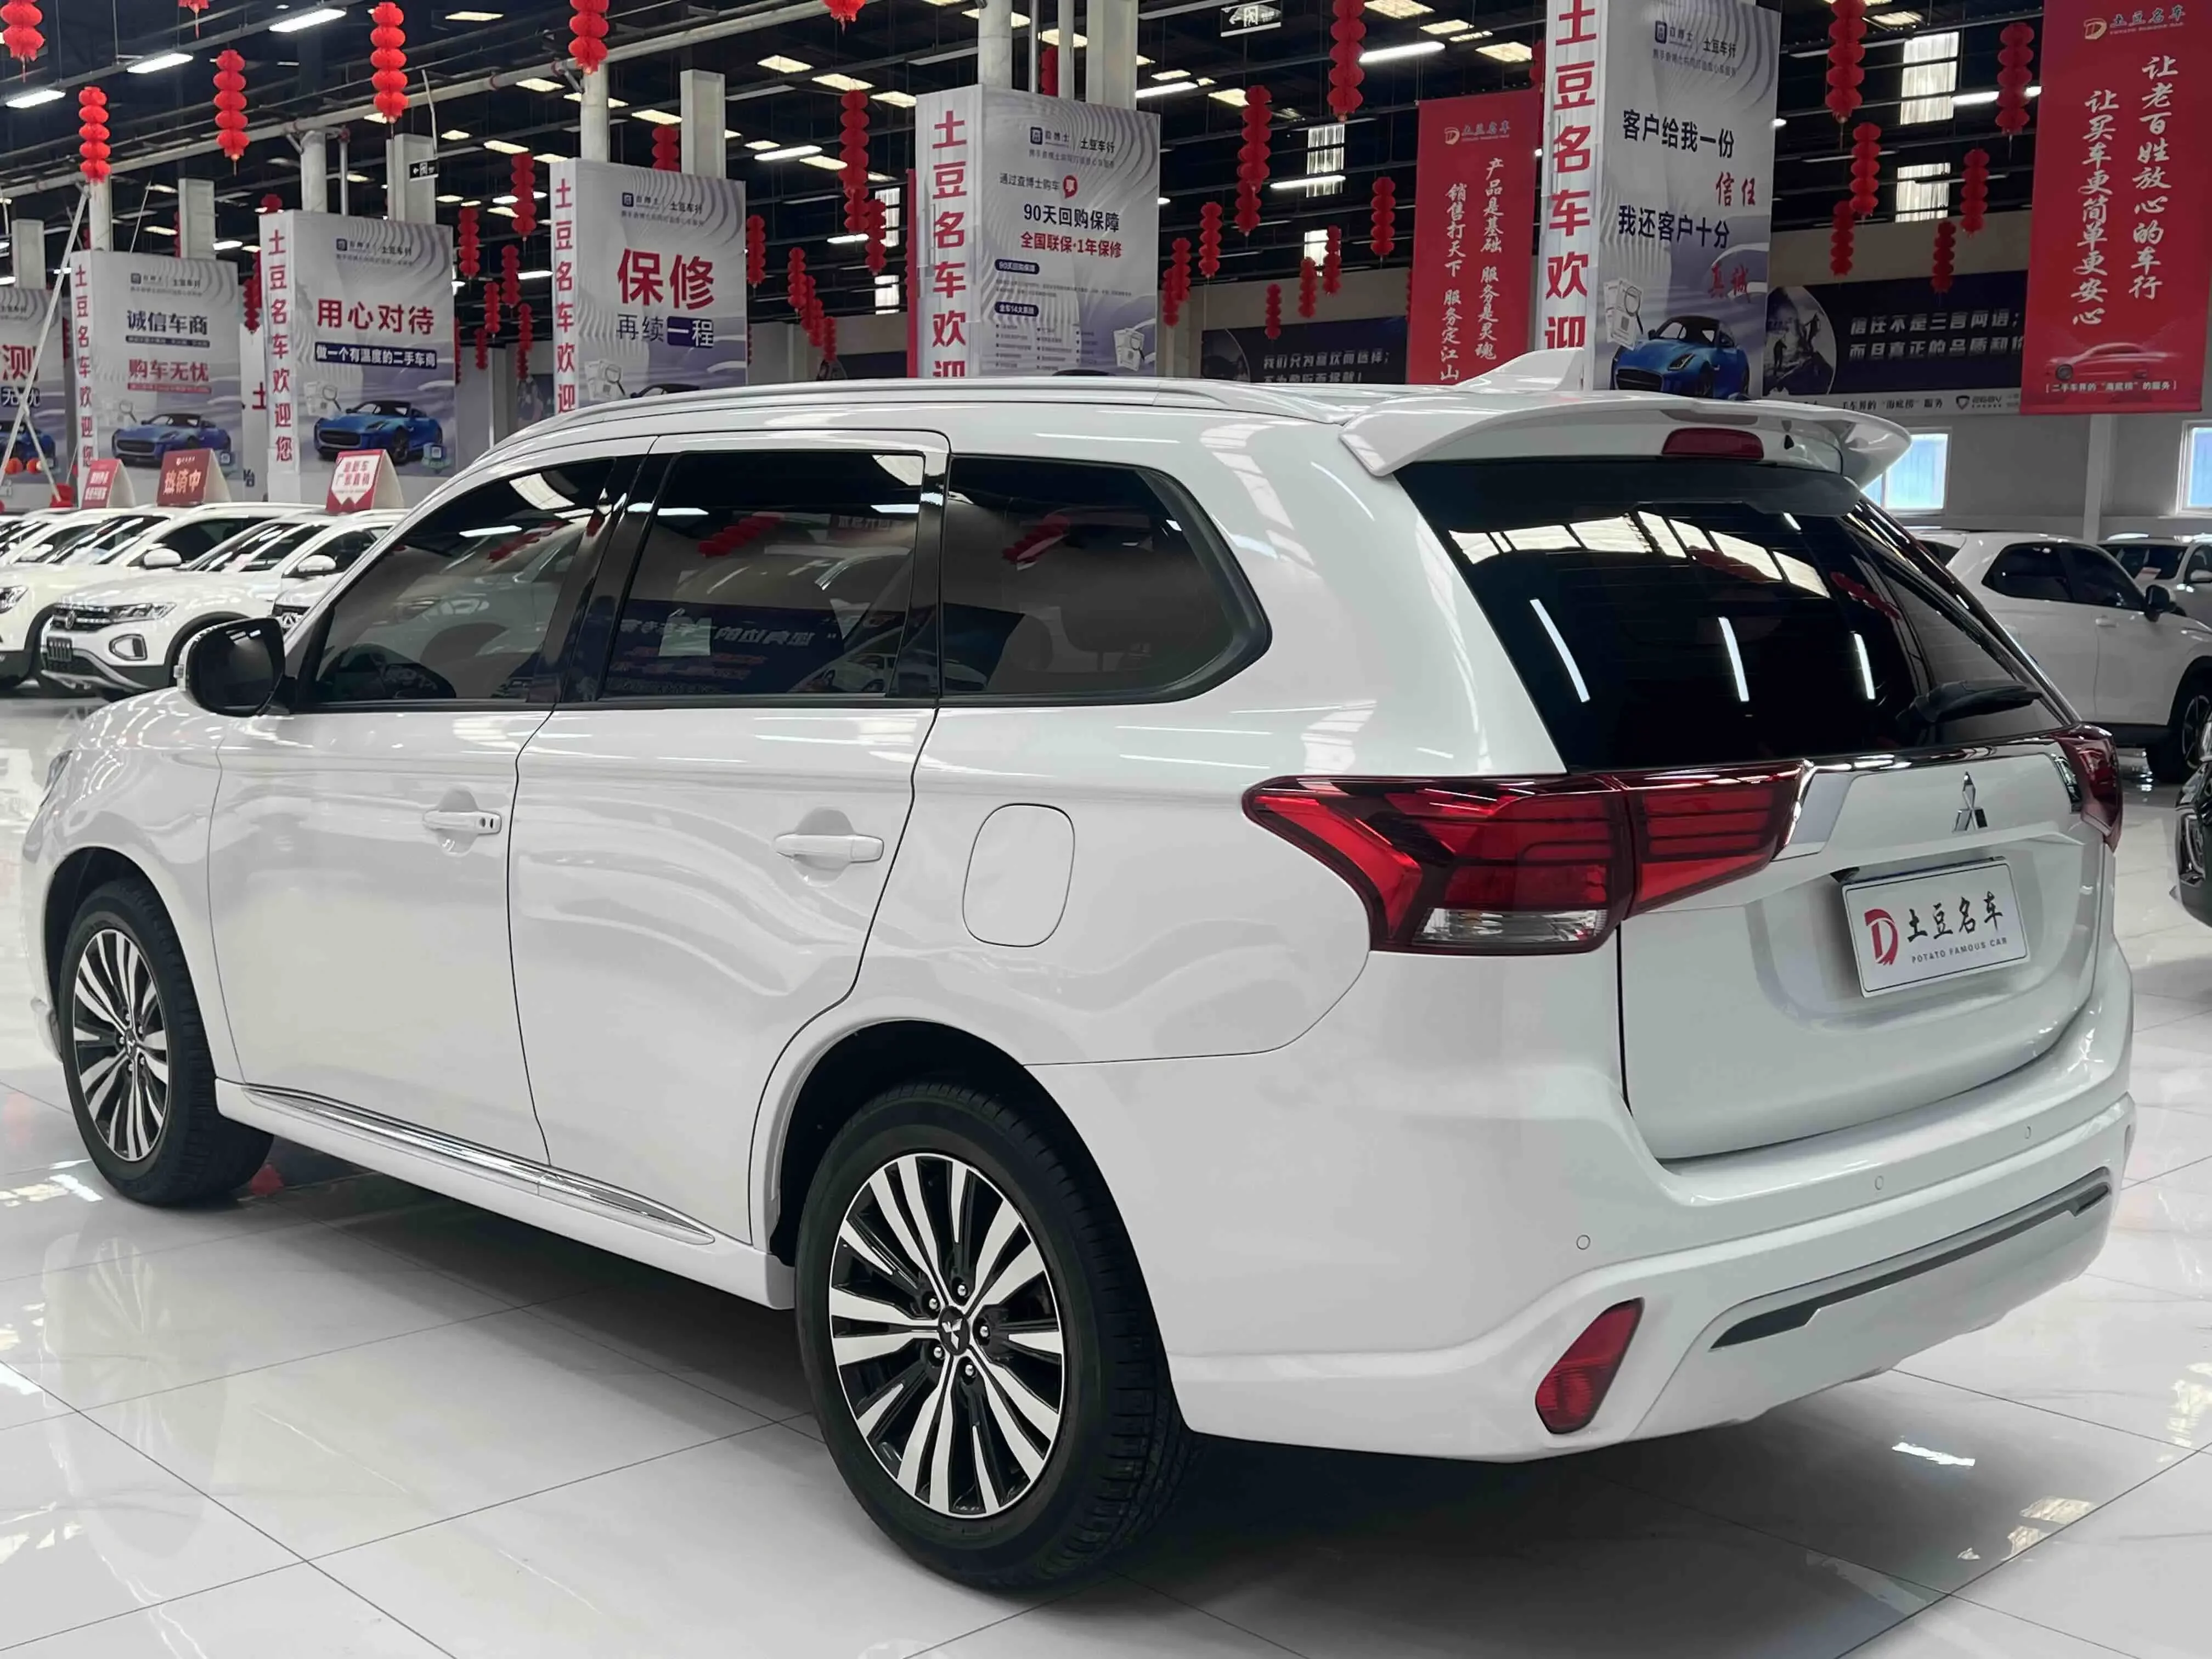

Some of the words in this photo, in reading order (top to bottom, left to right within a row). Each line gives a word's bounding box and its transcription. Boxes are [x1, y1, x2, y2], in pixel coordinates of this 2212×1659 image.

[1623, 110, 1734, 158] 客户给我一份
[1716, 171, 1756, 207] 信任
[2128, 55, 2179, 300] 让老百姓放心的车行
[1024, 204, 1120, 233] 90天回购保障
[1444, 183, 1468, 277] 销售打天下
[1480, 158, 1504, 253] 产品是基础
[1618, 205, 1730, 249] 我还客户十分
[2070, 89, 2119, 325] 让买车更简单更安心
[555, 179, 575, 413] 土豆名车欢迎
[617, 248, 715, 311] 保修
[127, 310, 208, 335] 诚信车商
[317, 298, 435, 335] 用心对待
[616, 313, 714, 347] 再续一程
[1440, 289, 1463, 381] 服务定江山
[1474, 266, 1500, 360] 服务是灵魂
[268, 229, 293, 461] 土豆名车欢迎您
[316, 345, 436, 367] 做一个有温度的二手车商
[128, 358, 210, 383] 购车无忧
[1907, 890, 2004, 943] 土豆名车
[1911, 949, 1946, 964] POTATO
[1949, 941, 1986, 956] FAMOUS
[1989, 936, 2007, 948] CAR
